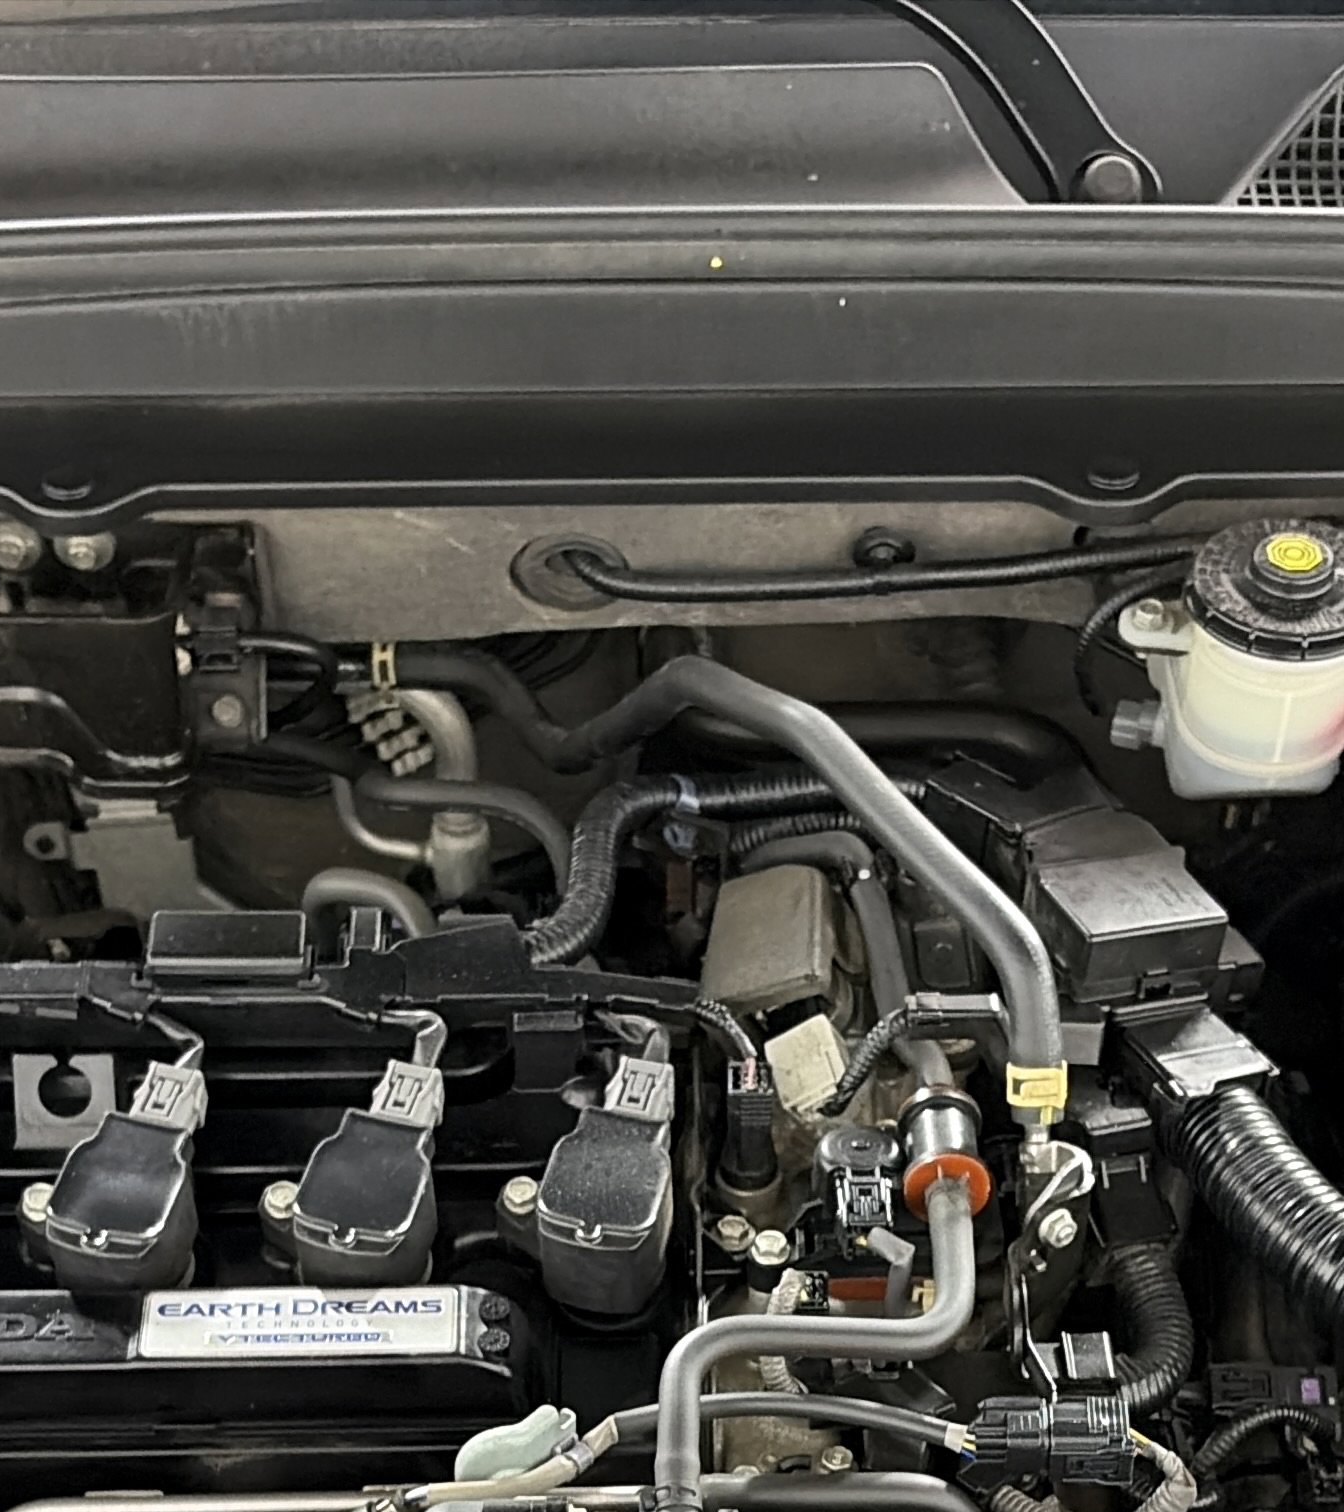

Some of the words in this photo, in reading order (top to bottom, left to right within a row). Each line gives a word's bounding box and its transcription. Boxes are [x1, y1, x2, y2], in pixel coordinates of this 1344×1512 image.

[157, 1301, 282, 1318] EARTH
[292, 1299, 443, 1317] DREAMS
[226, 1319, 375, 1329] TECHNOLOGY
